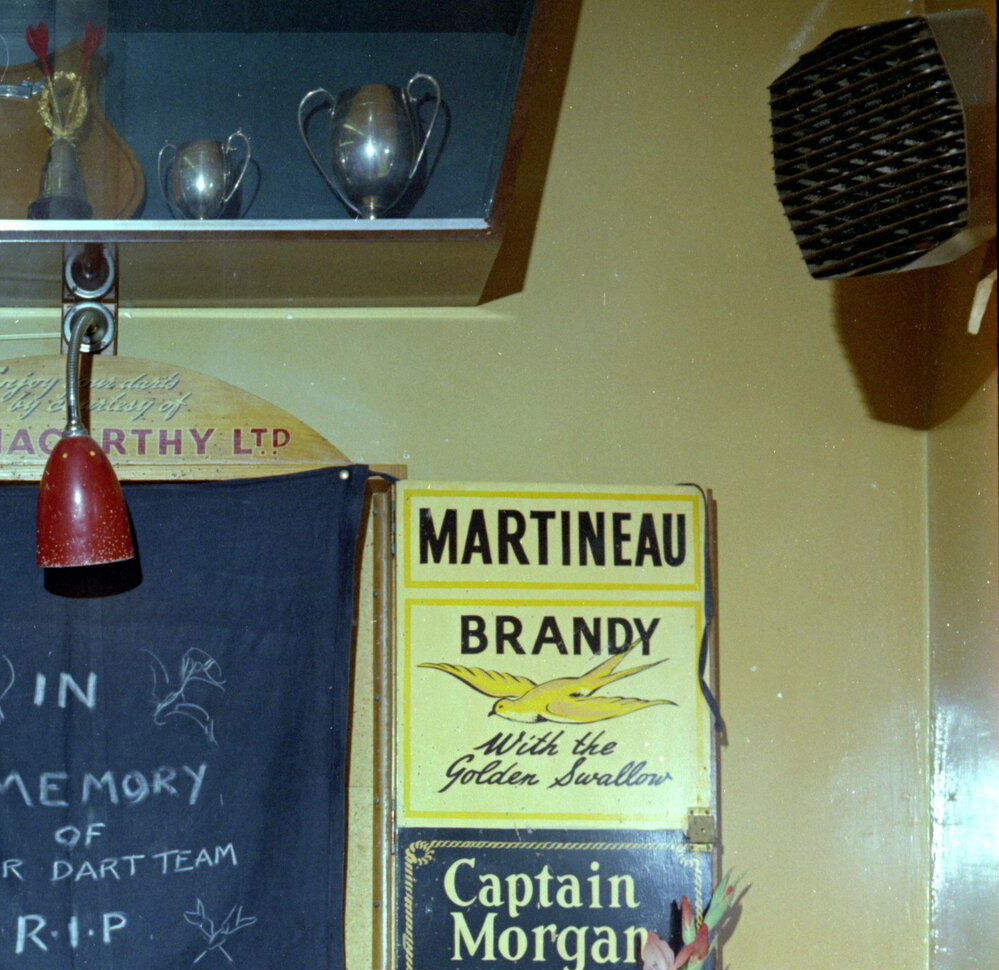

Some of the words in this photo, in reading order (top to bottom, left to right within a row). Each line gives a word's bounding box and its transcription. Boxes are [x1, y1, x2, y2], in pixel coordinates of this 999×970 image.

[120, 372, 180, 390] darts
[8, 392, 41, 421] by
[48, 394, 154, 421] curtesy
[158, 392, 192, 422] of
[418, 507, 687, 567] MARTINEAU
[459, 615, 661, 656] BRANDY
[33, 671, 97, 709] IN
[474, 730, 565, 756] With
[574, 730, 618, 756] the
[437, 753, 540, 793] Golden
[547, 757, 673, 789] Swallow
[55, 823, 106, 847] OF
[51, 854, 145, 882] DART
[152, 842, 238, 875] TEAM
[443, 857, 641, 918] Captain
